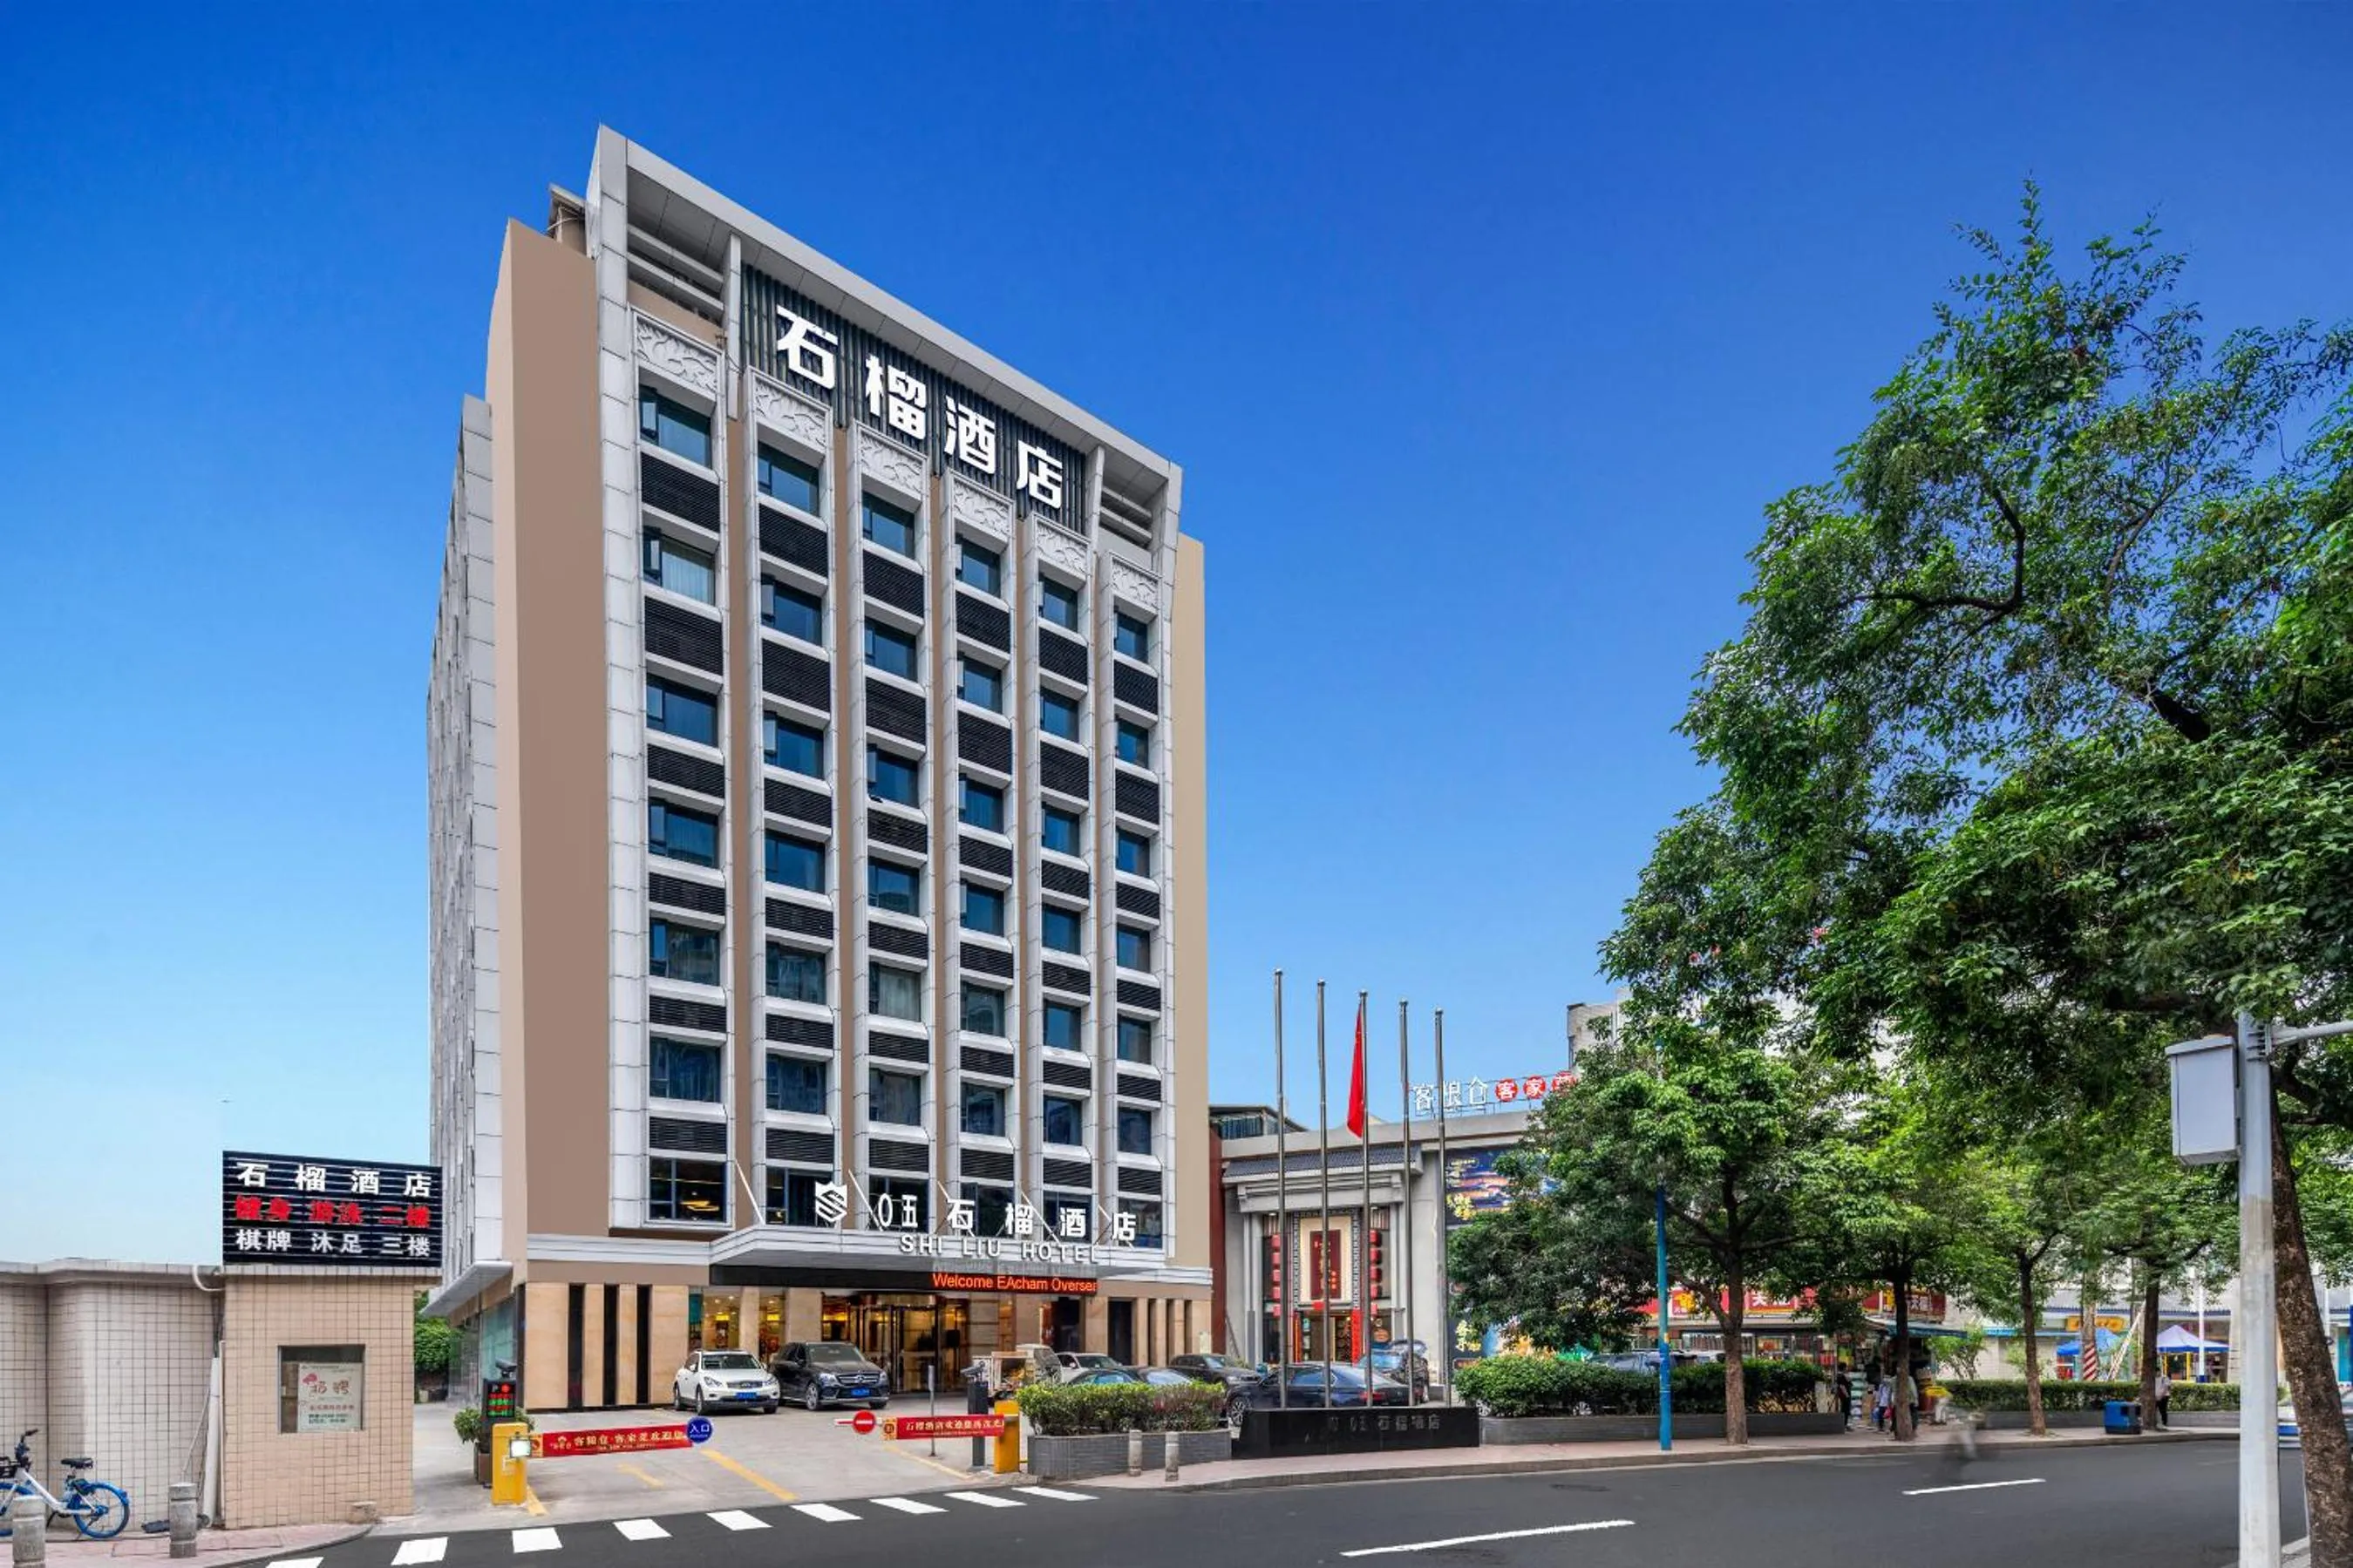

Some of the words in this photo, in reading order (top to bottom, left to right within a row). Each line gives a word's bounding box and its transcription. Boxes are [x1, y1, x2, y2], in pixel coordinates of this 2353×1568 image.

[776, 304, 1064, 509] 石榴酒店
[236, 1162, 432, 1198] 石榴酒店
[946, 1198, 1138, 1242] 石榴酒店
[235, 1228, 292, 1252] 棋牌
[310, 1232, 364, 1254] 沐足
[380, 1234, 431, 1258] 三楼
[901, 1234, 943, 1255] SHI
[962, 1238, 1002, 1258] LIU
[1022, 1242, 1098, 1265] HOTEL
[933, 1273, 994, 1290] Welcome
[997, 1275, 1048, 1291] EAcham
[690, 1422, 710, 1434] 入口
